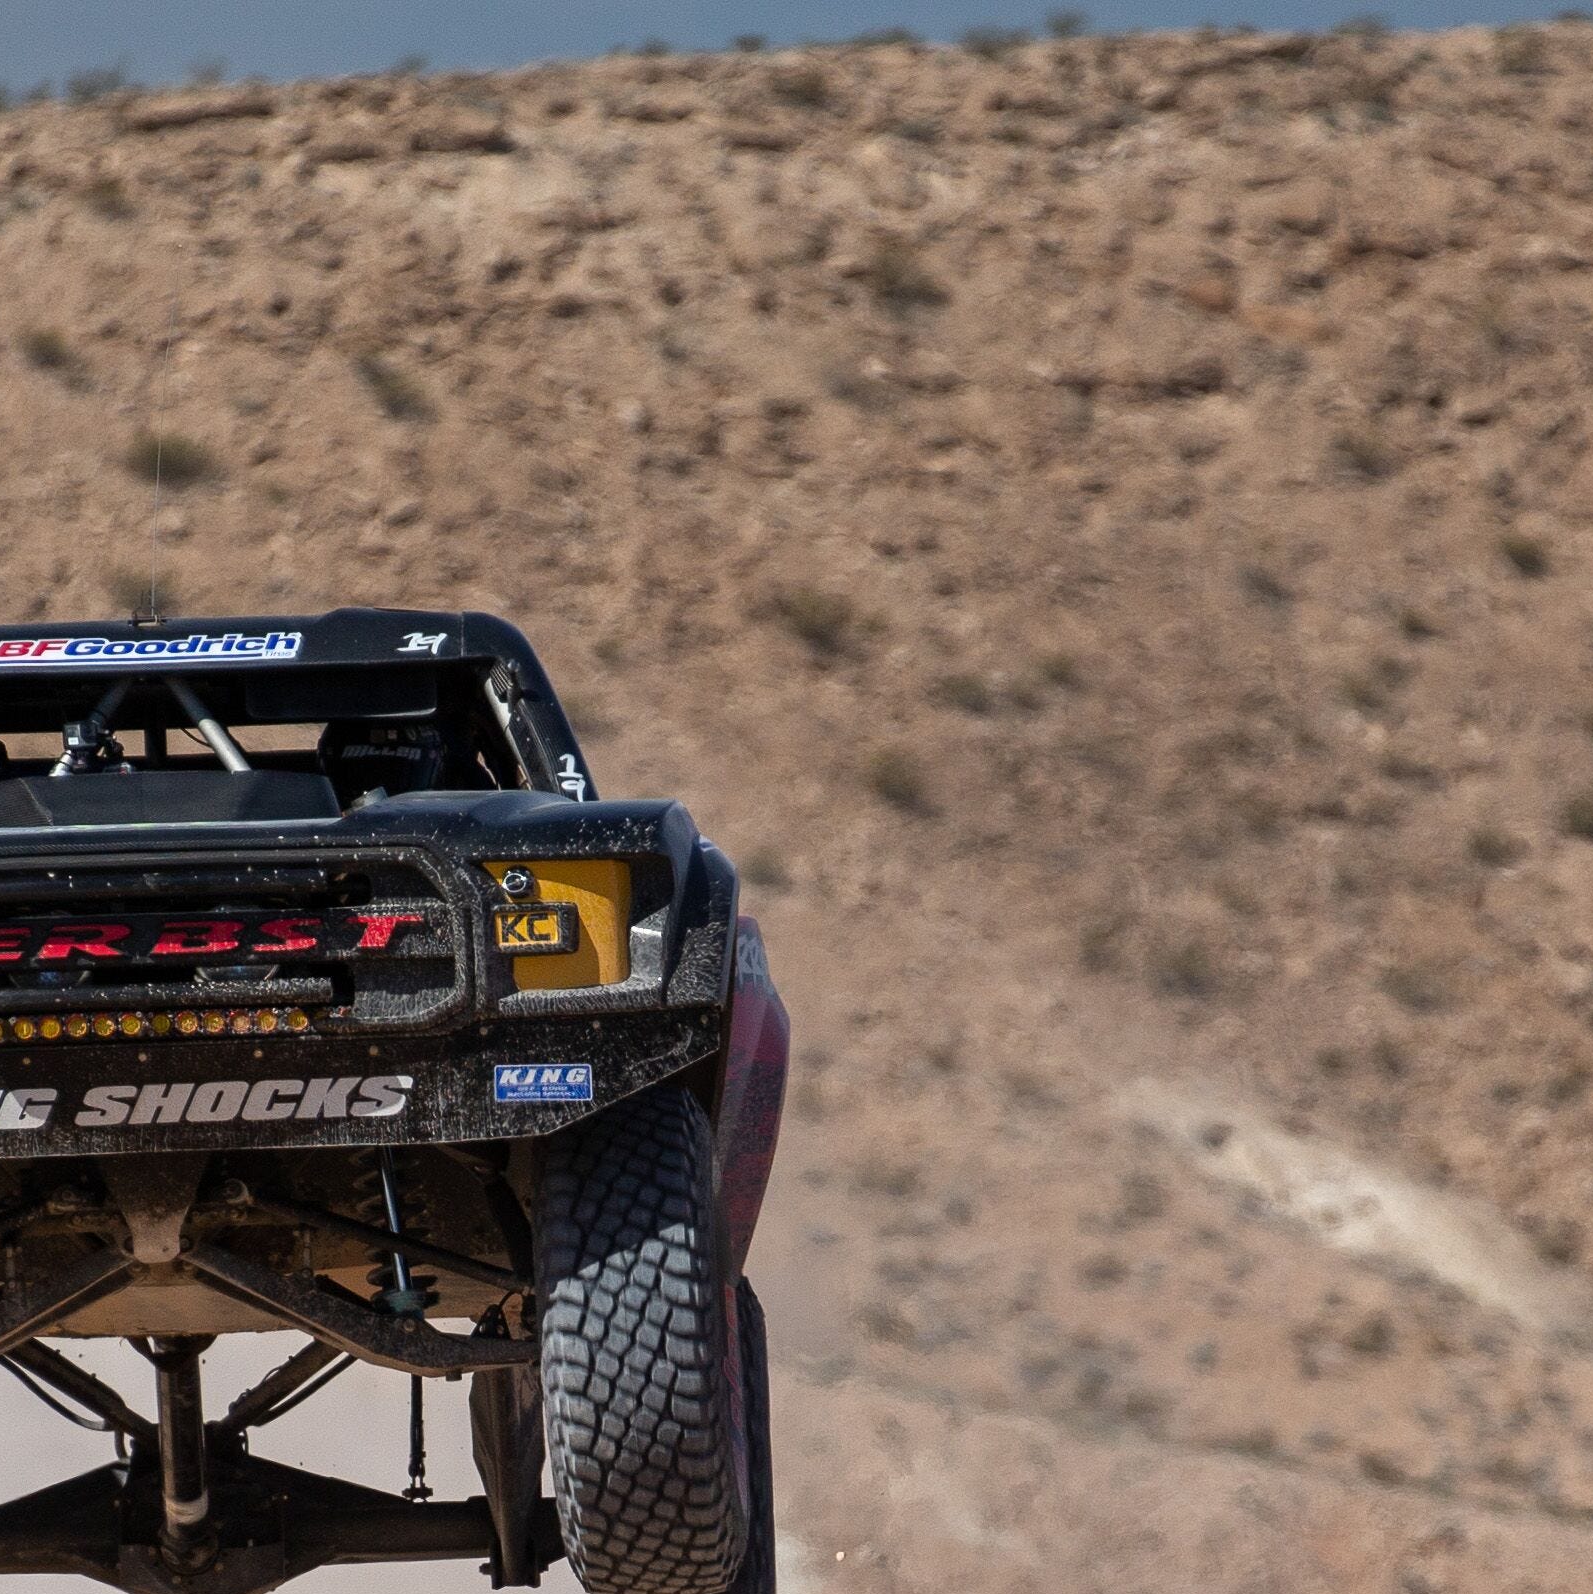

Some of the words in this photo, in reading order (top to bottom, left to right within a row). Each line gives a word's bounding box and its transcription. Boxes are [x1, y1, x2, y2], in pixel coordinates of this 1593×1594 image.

[501, 912, 551, 943] KC
[498, 1067, 588, 1086] KING
[73, 1075, 414, 1127] SHOCKS
